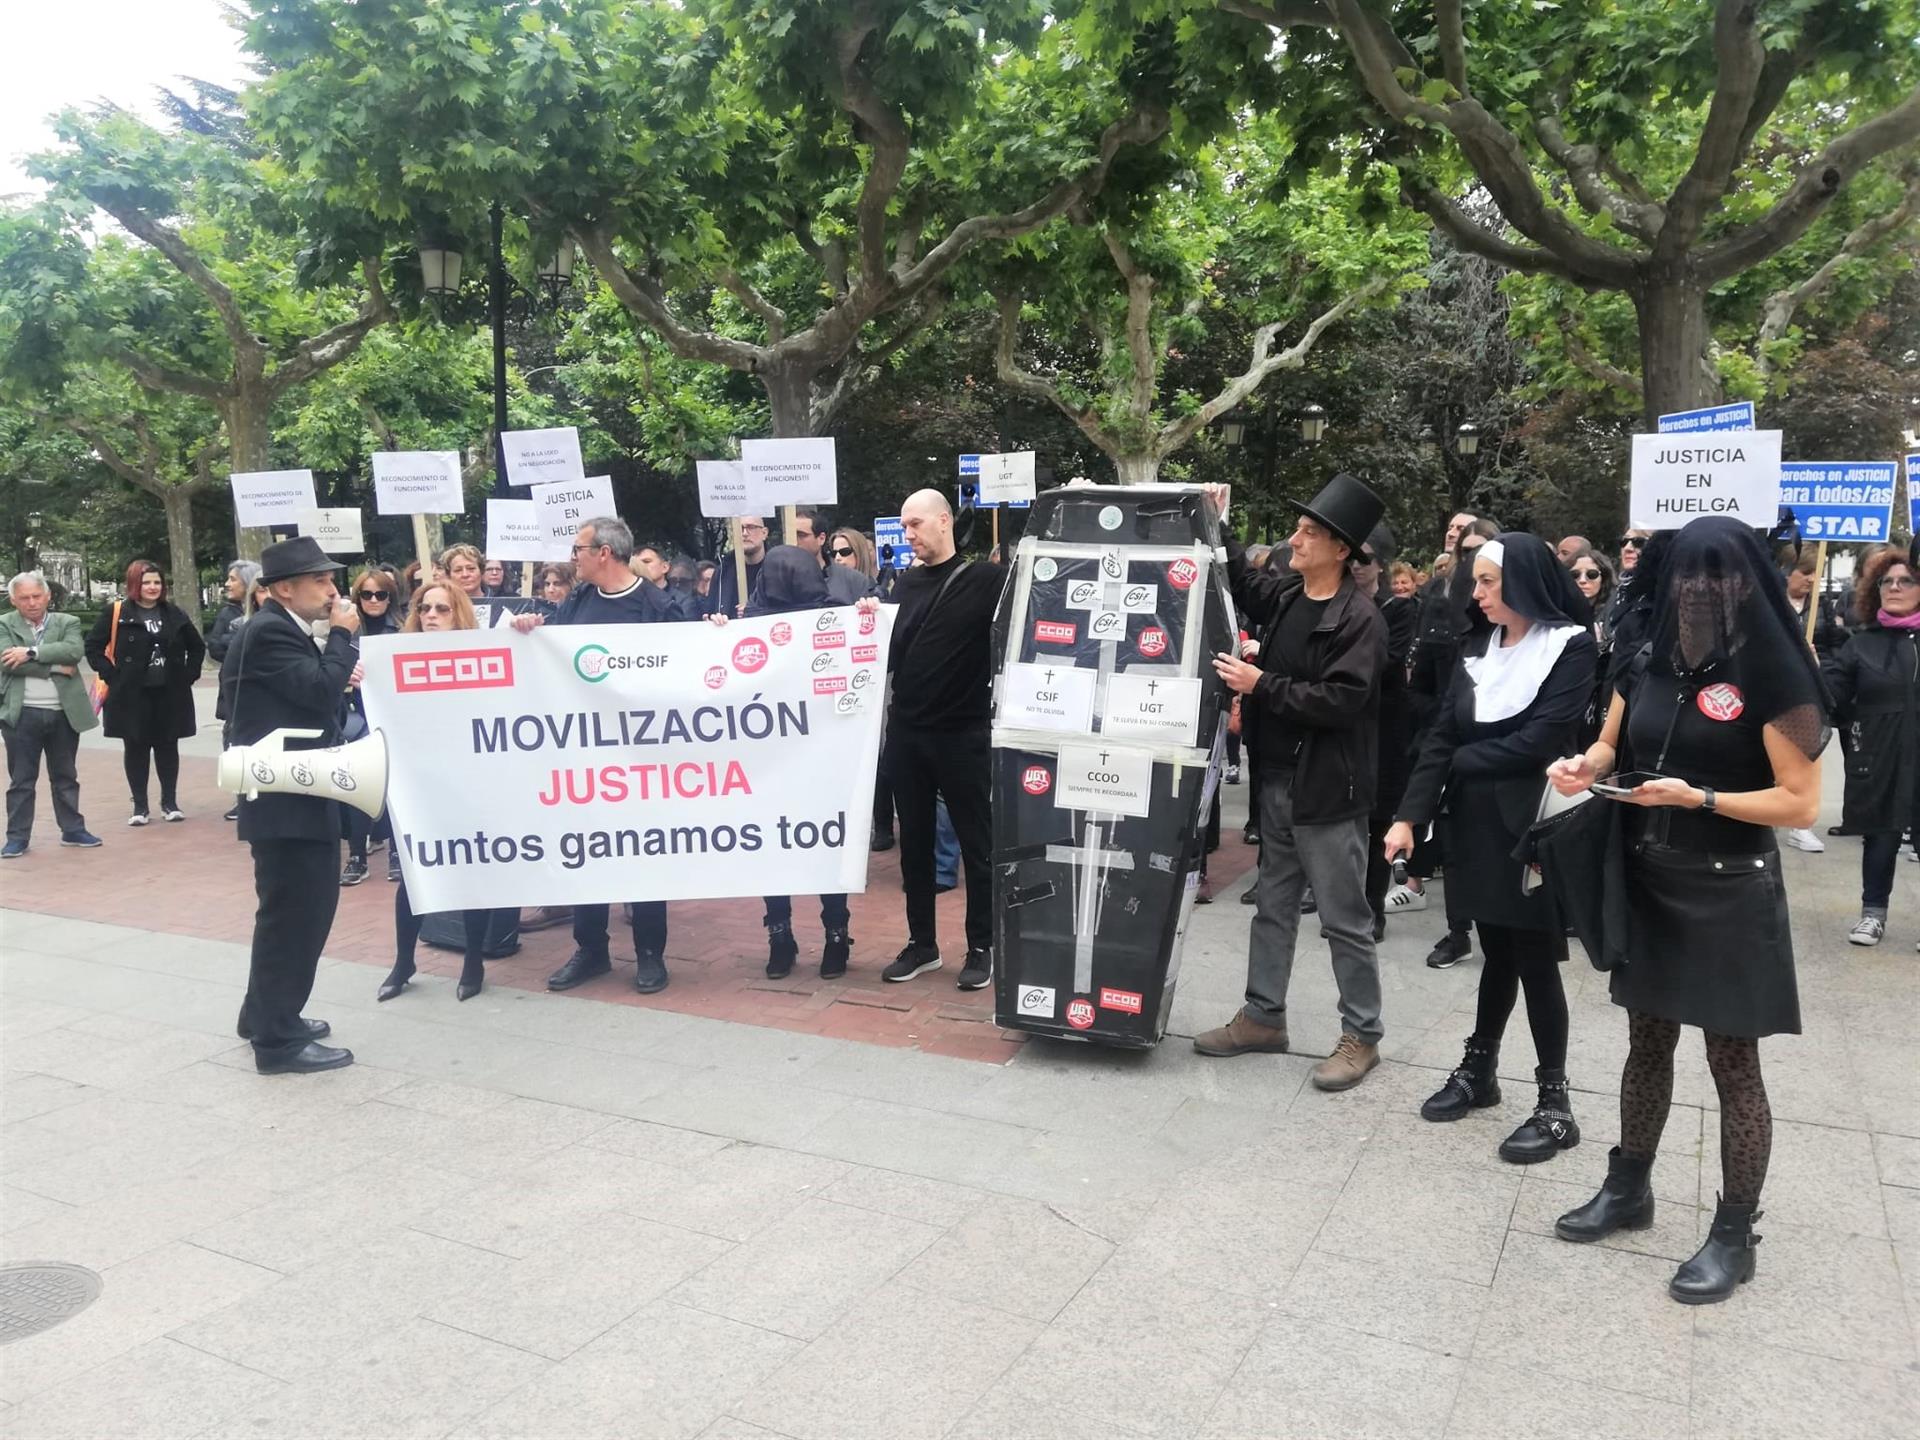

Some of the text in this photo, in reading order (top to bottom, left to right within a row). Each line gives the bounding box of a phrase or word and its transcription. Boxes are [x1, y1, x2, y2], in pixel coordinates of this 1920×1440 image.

[1714, 408, 1749, 424] JUSTICIA
[1654, 448, 1745, 464] JUSTICIA
[751, 463, 812, 472] RECONOCIMIENTO
[381, 474, 439, 482] RECONOCIMIENTO
[998, 472, 1013, 480] UGT
[1686, 473, 1712, 488] EN
[1828, 470, 1842, 482] en
[1844, 469, 1891, 482] JUSTICIA
[545, 489, 594, 505] JUSTICIA
[1814, 484, 1892, 503] todos/as
[1656, 498, 1740, 512] HUELGA
[564, 508, 580, 519] EN
[319, 525, 340, 533] CCOO
[1806, 516, 1882, 536] STAR
[1038, 624, 1073, 637] CCOO
[1140, 630, 1165, 644] UGT
[400, 655, 507, 686] CCOO
[1036, 690, 1060, 702] CSIF
[1026, 705, 1036, 713] NO
[1139, 702, 1164, 713] UGT
[472, 693, 810, 753] MOVILIZACIÓN
[1121, 716, 1138, 724] LLEVA
[1158, 720, 1188, 728] CORAZÓN
[1025, 768, 1048, 781] UGT
[1087, 771, 1120, 784] CCOO
[538, 760, 753, 806] JUSTICIA
[1068, 785, 1093, 793] SIEMPRE
[560, 822, 763, 869] ganamos
[776, 811, 847, 850] tod
[1103, 991, 1141, 1007] CCOO
[1070, 1002, 1093, 1017] UGT
